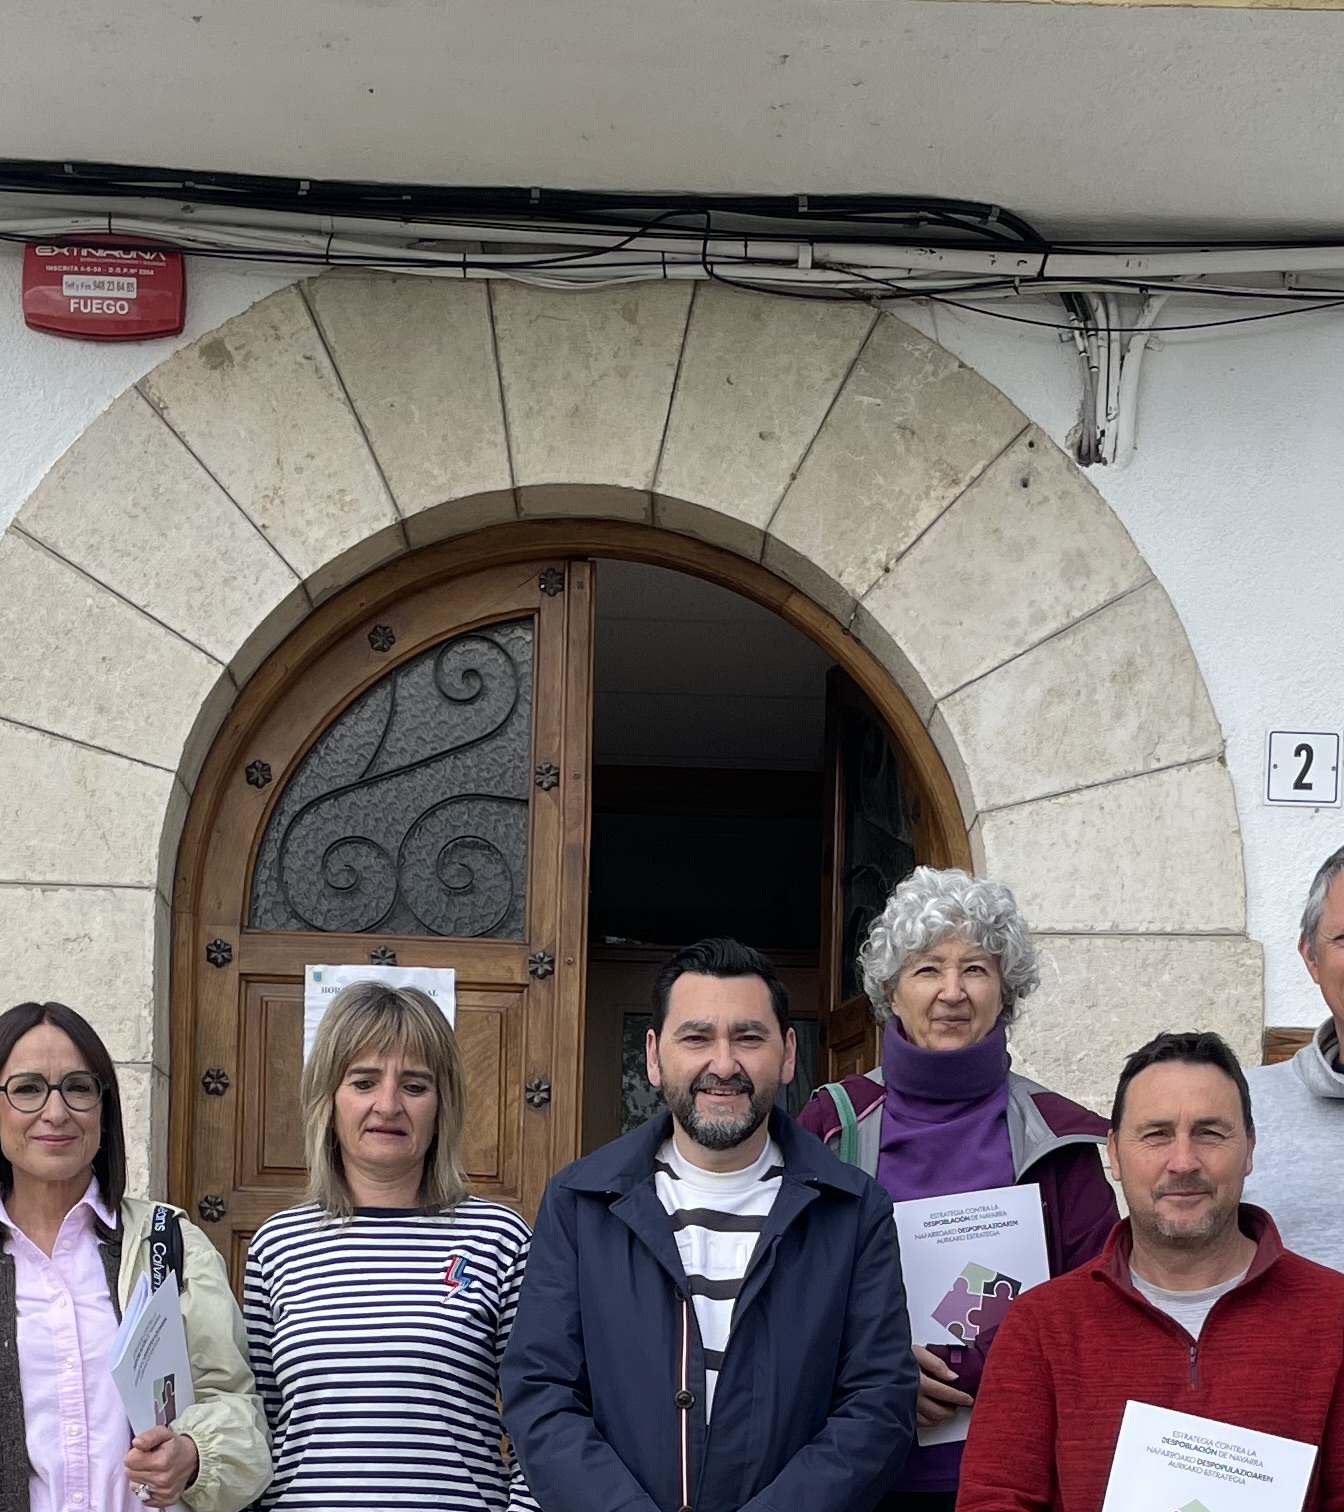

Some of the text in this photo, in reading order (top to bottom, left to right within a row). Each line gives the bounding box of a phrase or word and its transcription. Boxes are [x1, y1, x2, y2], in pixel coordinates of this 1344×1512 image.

[70, 299, 129, 314] FUEGO
[1292, 743, 1314, 791] 2
[1172, 1430, 1257, 1457] ESTRATEGIA CONTRA LA
[1218, 1450, 1228, 1458] DE
[1228, 1453, 1264, 1468] NAVARRA
[1203, 1468, 1246, 1485] ESTRATEGIA
